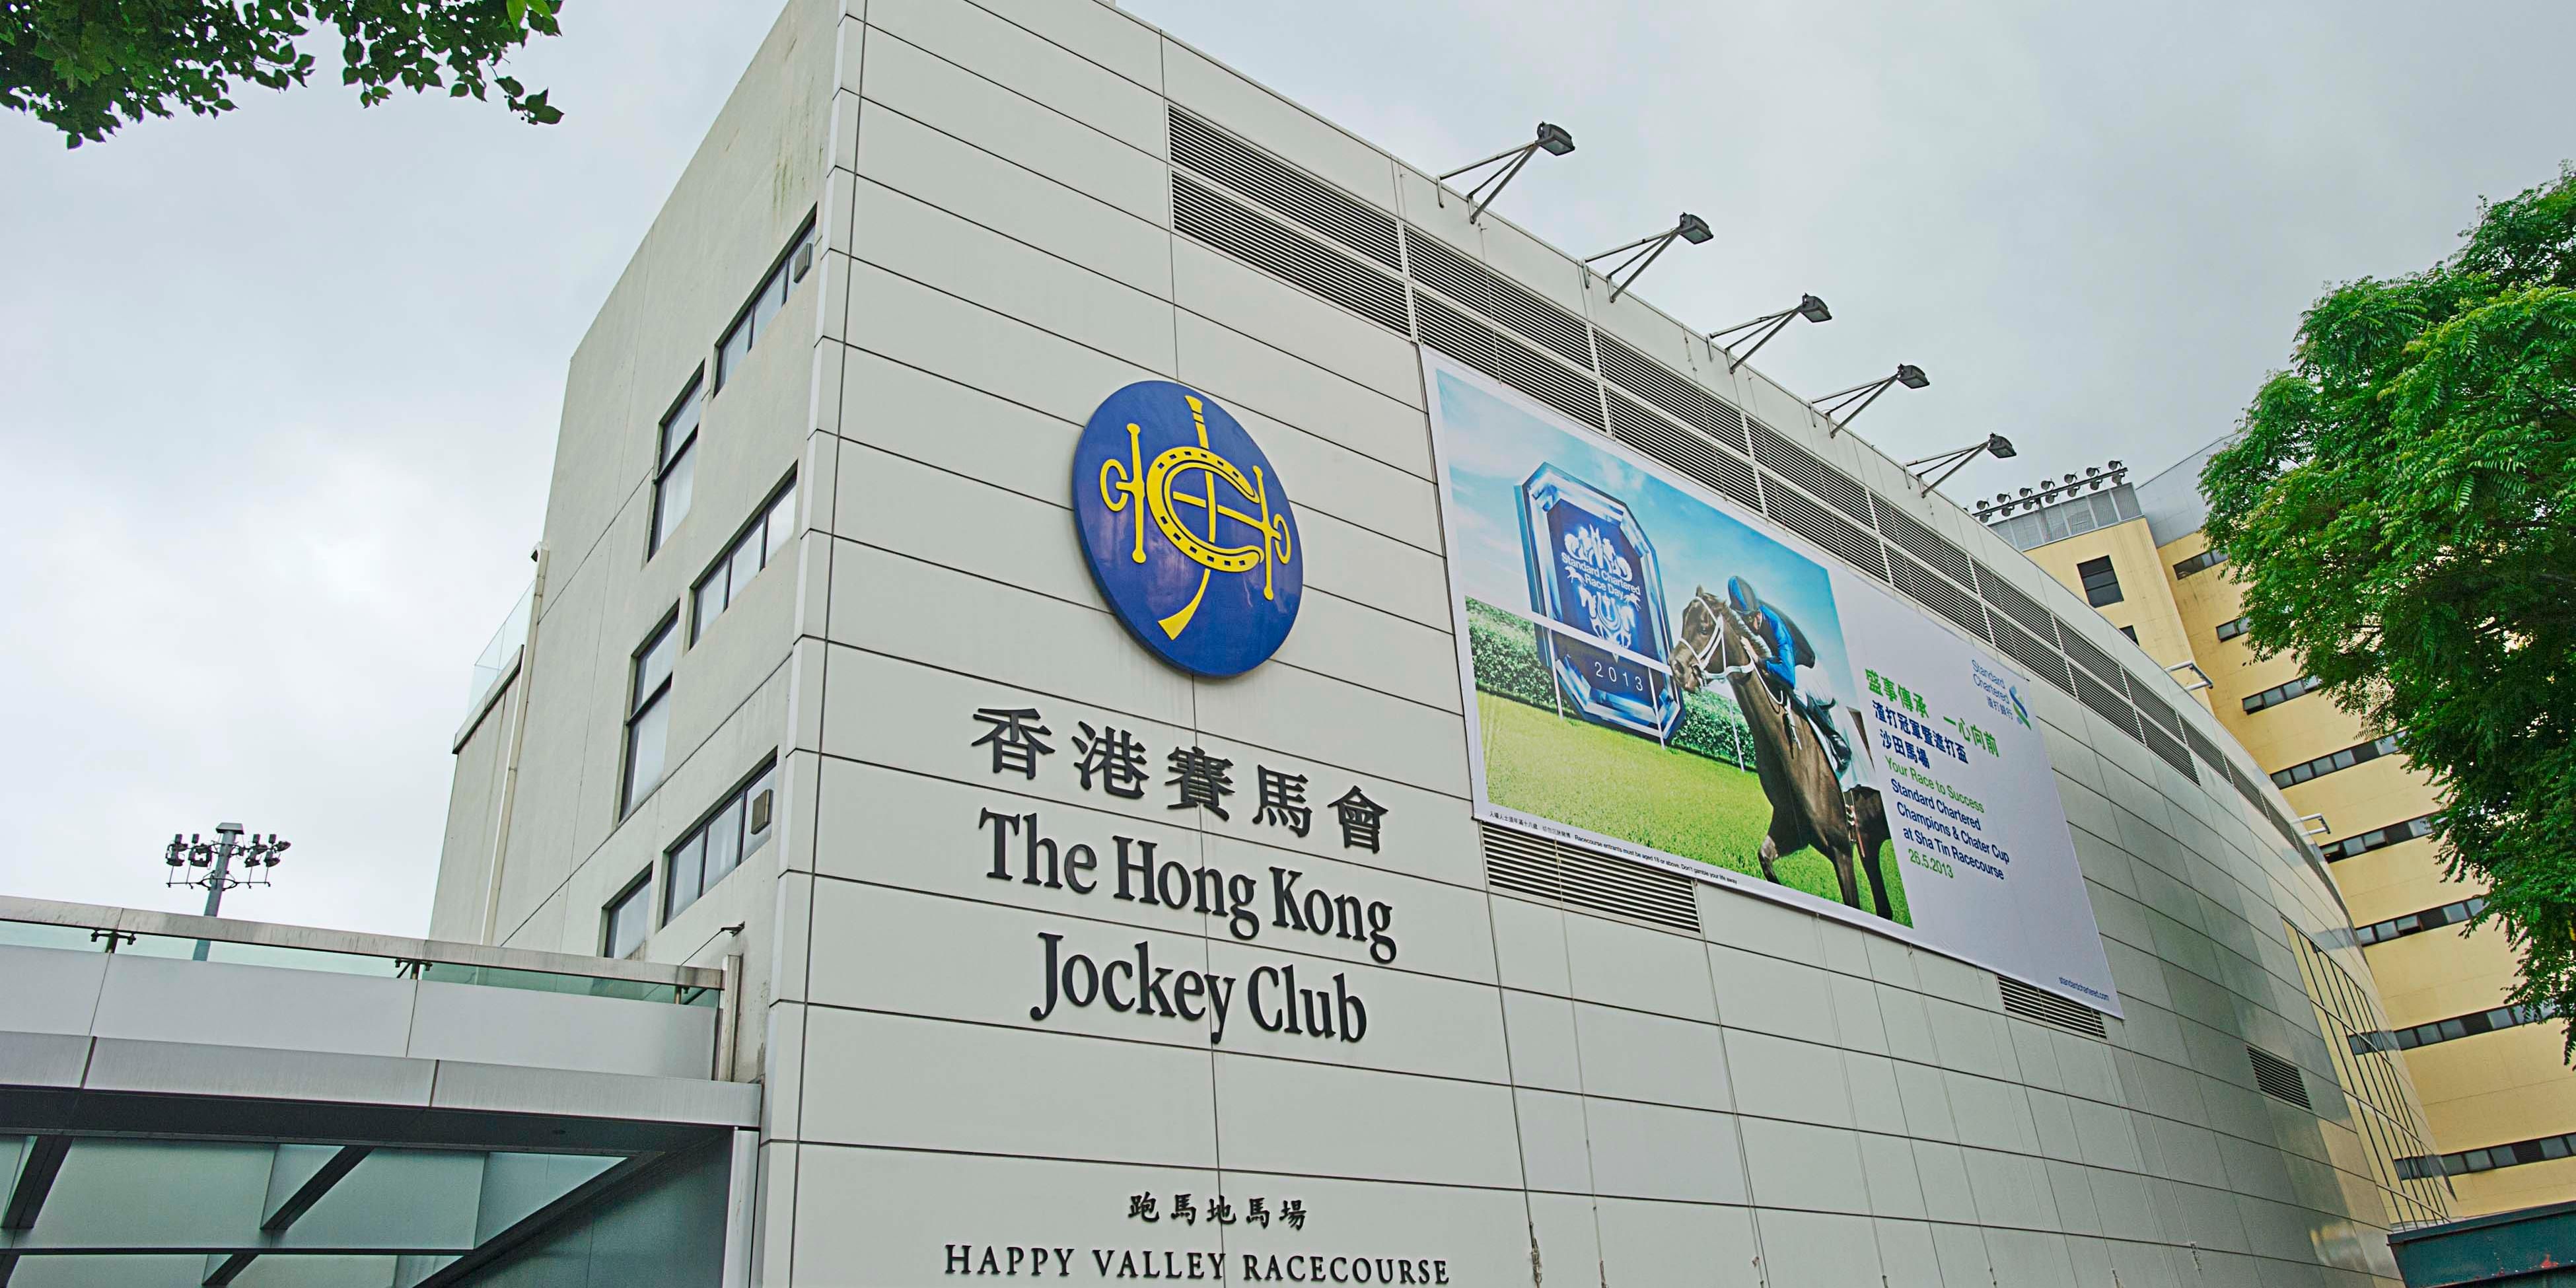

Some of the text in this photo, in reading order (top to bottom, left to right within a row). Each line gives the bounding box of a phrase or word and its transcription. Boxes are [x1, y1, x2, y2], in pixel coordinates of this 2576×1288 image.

[1561, 552, 1641, 596] Standard Chartered
[1585, 573, 1624, 600] Race Day
[1594, 662, 1644, 692] 2013
[1972, 659, 2005, 689] Standard
[1973, 673, 2010, 705] Chartered
[1865, 668, 1999, 758] 盛事傳承 一心向前
[1872, 699, 1969, 765] 渣打冠軍暨遮打盃
[1879, 728, 1931, 769] 沙田馬場
[972, 707, 1389, 854] 香港賽馬會
[1885, 756, 1985, 814] Your Race to Success
[1890, 778, 1982, 832] Standard Chartered
[1897, 801, 2010, 865] Champions & Chater Cup
[1902, 827, 2005, 880] at Sha Tin Racecourse
[979, 806, 1398, 964] The Hong Kong
[1908, 848, 1954, 879] 26.5.2013
[1029, 931, 1367, 1044] Jockey Club
[1127, 1191, 1308, 1231] 跑馬地馬場
[944, 1243, 1450, 1285] HAPPY VALLEY RACECOURSE
